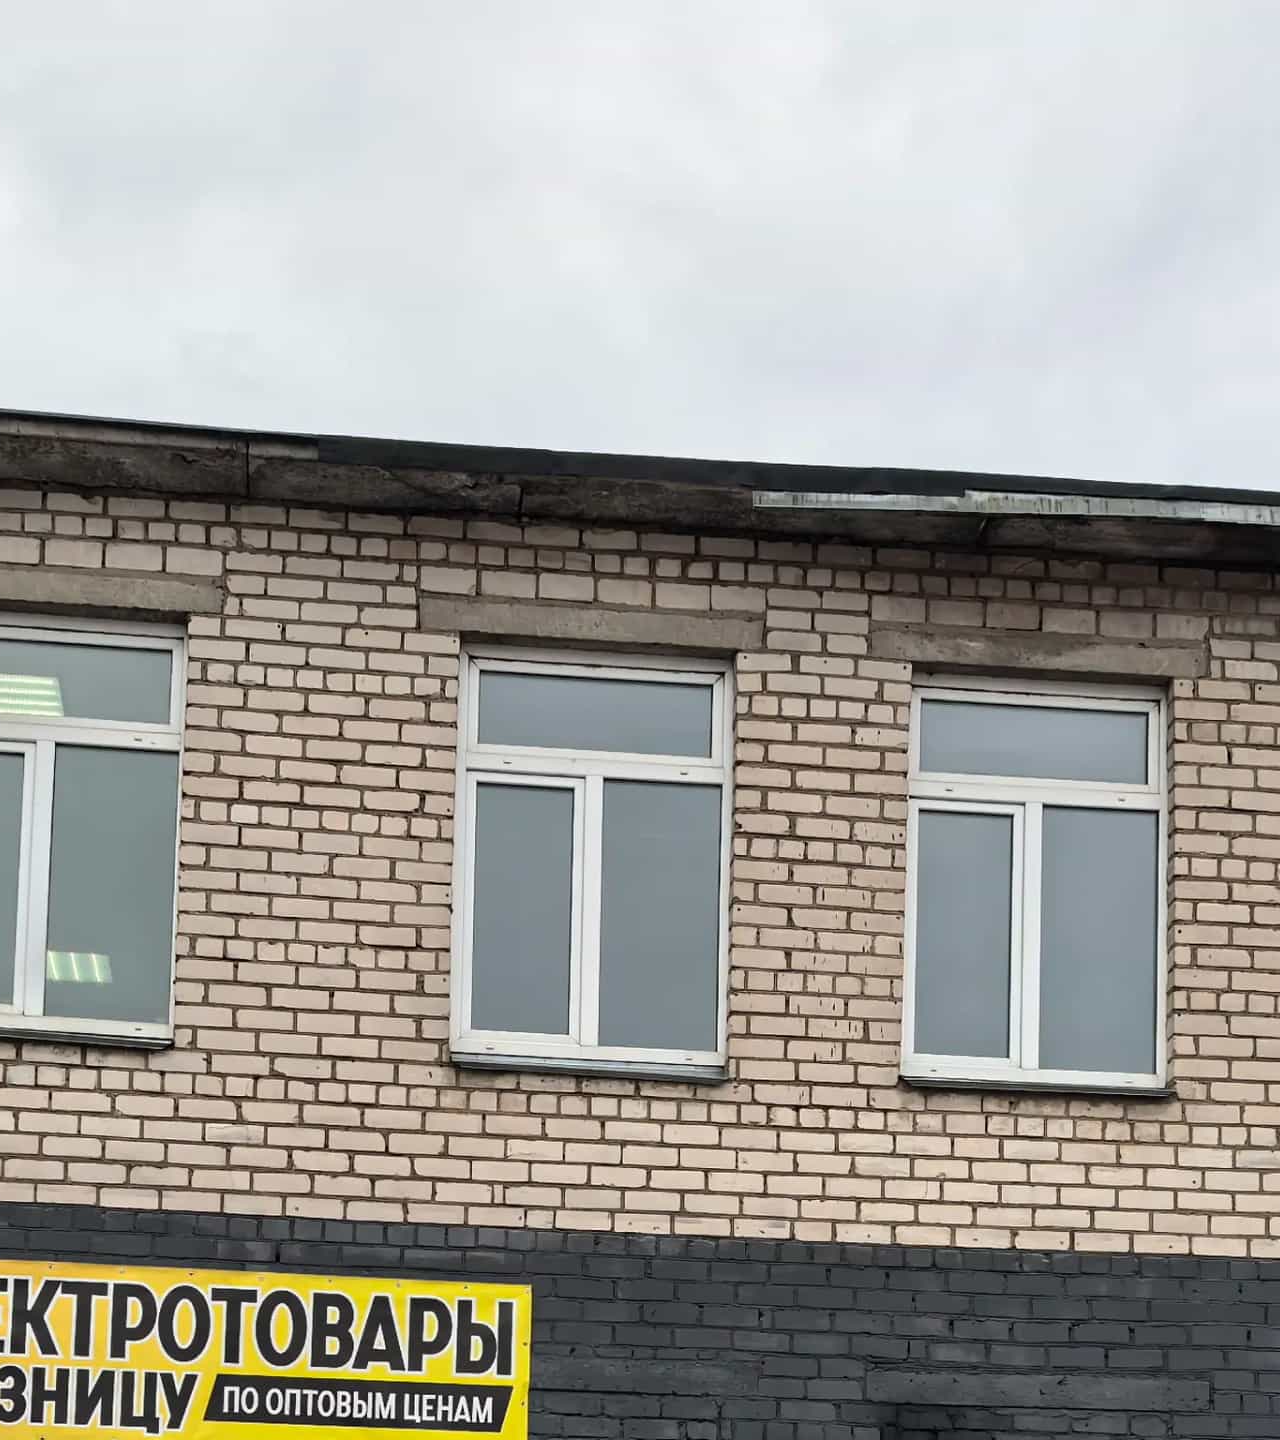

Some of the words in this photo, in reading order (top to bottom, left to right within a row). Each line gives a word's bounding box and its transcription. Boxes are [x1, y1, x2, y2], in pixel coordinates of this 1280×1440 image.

[222, 1386, 258, 1416] ПО
[265, 1387, 397, 1421] ОПТОВЫМ
[404, 1392, 494, 1425] ЦЕНАМ
